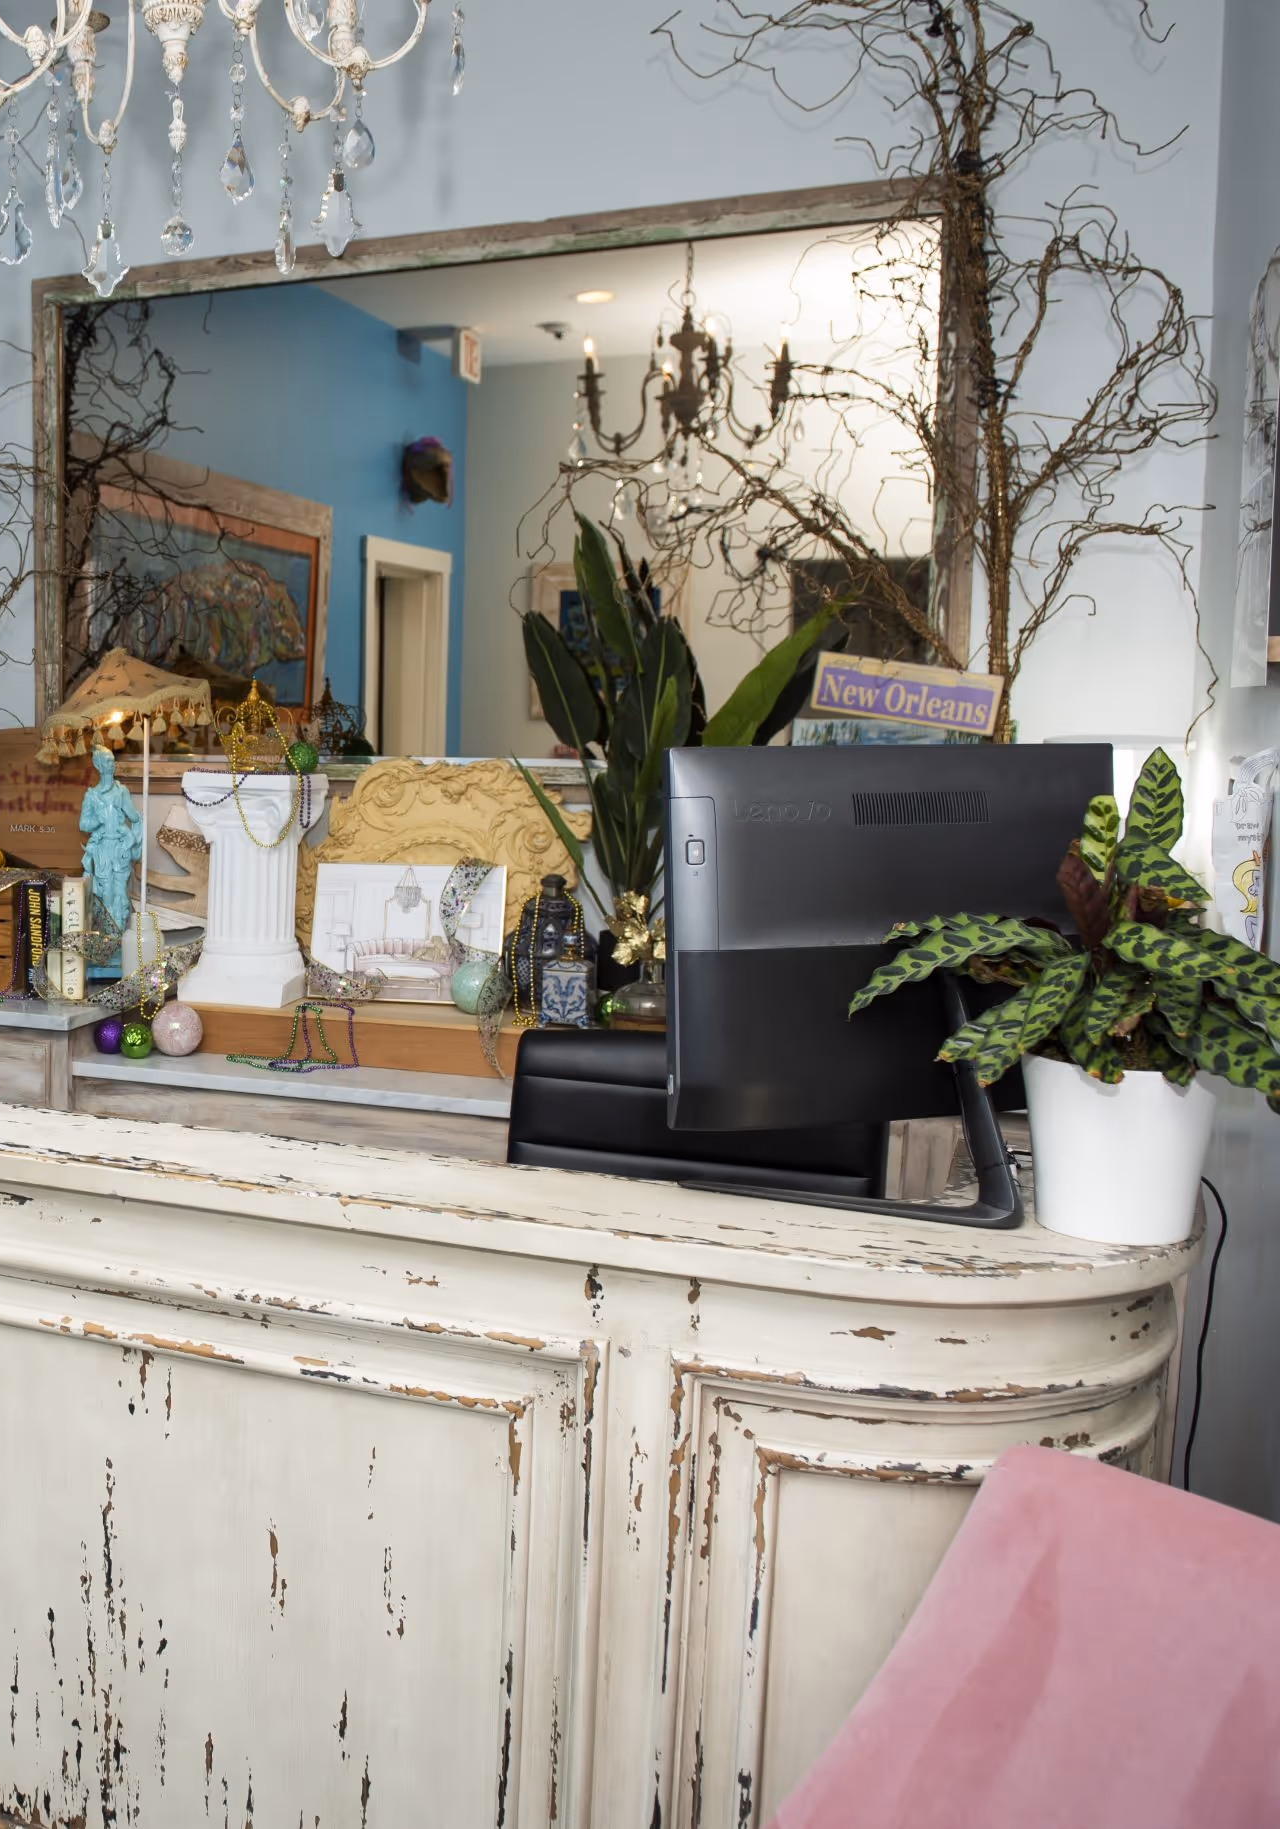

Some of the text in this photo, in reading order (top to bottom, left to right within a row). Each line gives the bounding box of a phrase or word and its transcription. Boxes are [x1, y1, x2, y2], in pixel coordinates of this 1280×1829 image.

[821, 673, 988, 726] New Orleans
[10, 824, 36, 833] MARK
[28, 888, 41, 915] JOHN
